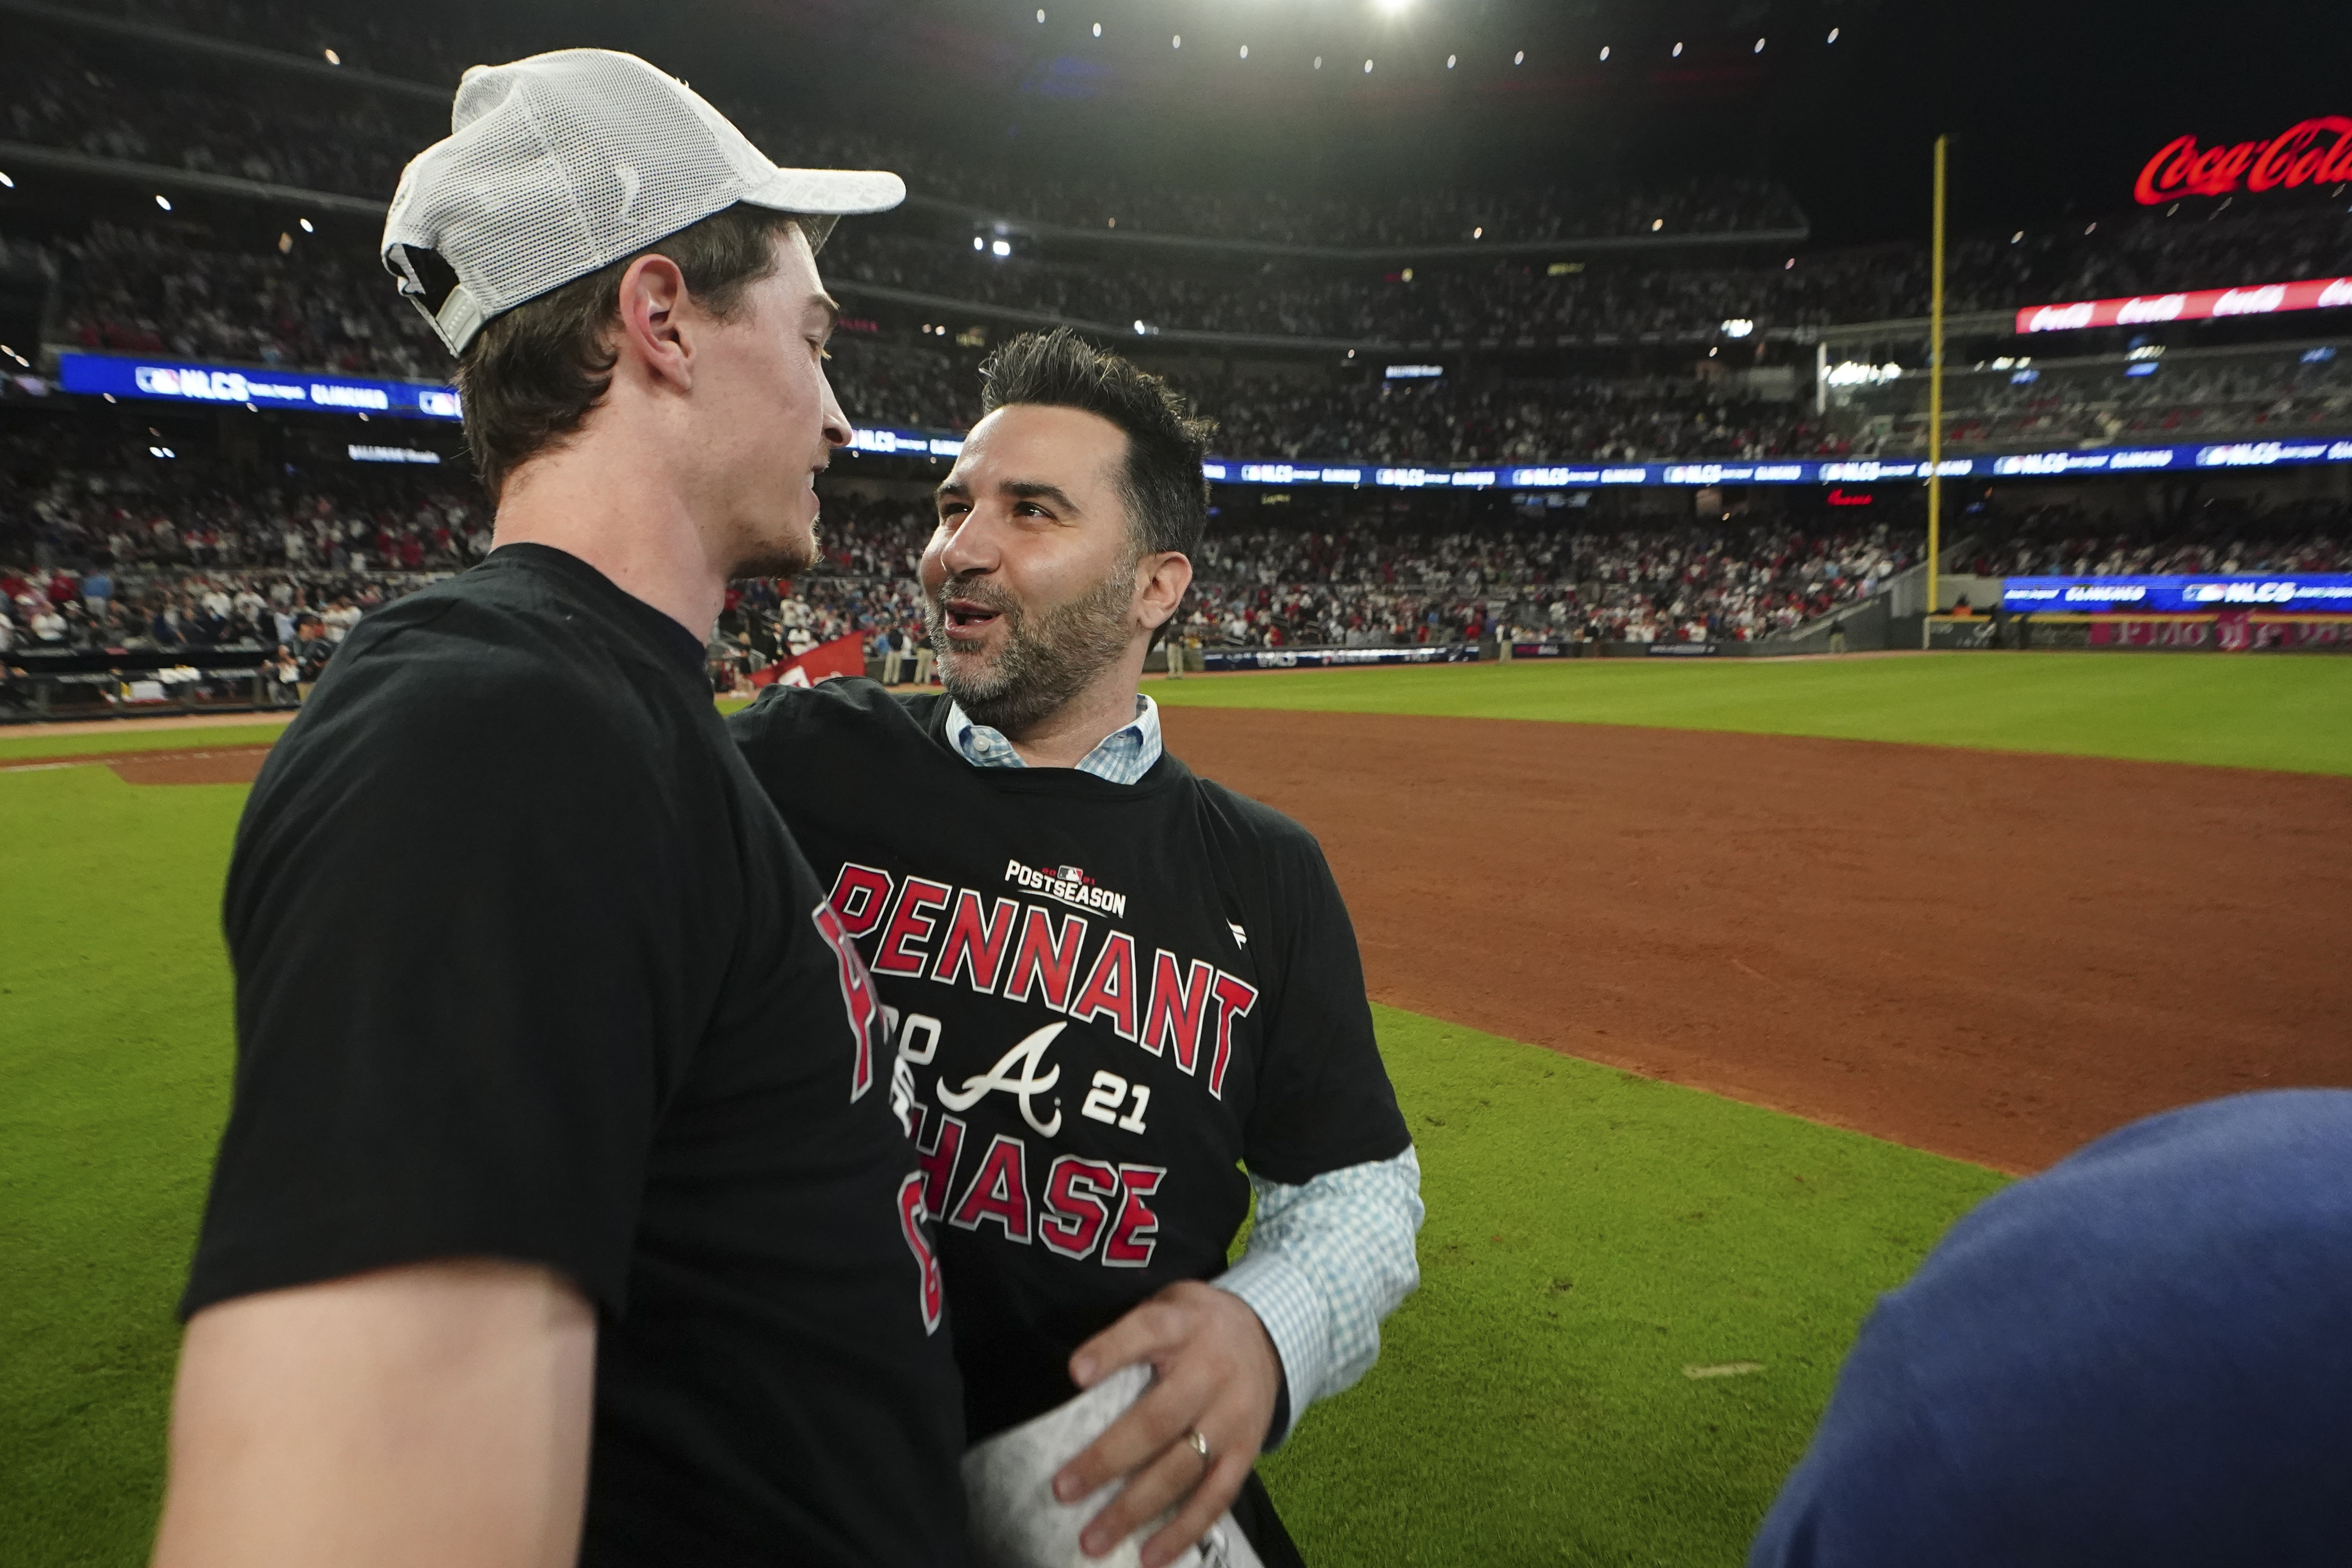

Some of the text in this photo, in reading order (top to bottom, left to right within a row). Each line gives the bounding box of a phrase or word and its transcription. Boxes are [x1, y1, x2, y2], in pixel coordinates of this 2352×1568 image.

[1005, 858, 1126, 919] POSTSEASON
[829, 862, 1259, 1101] PENNANT
[1081, 1070, 1151, 1135] 21
[910, 1102, 1167, 1268] HASE
